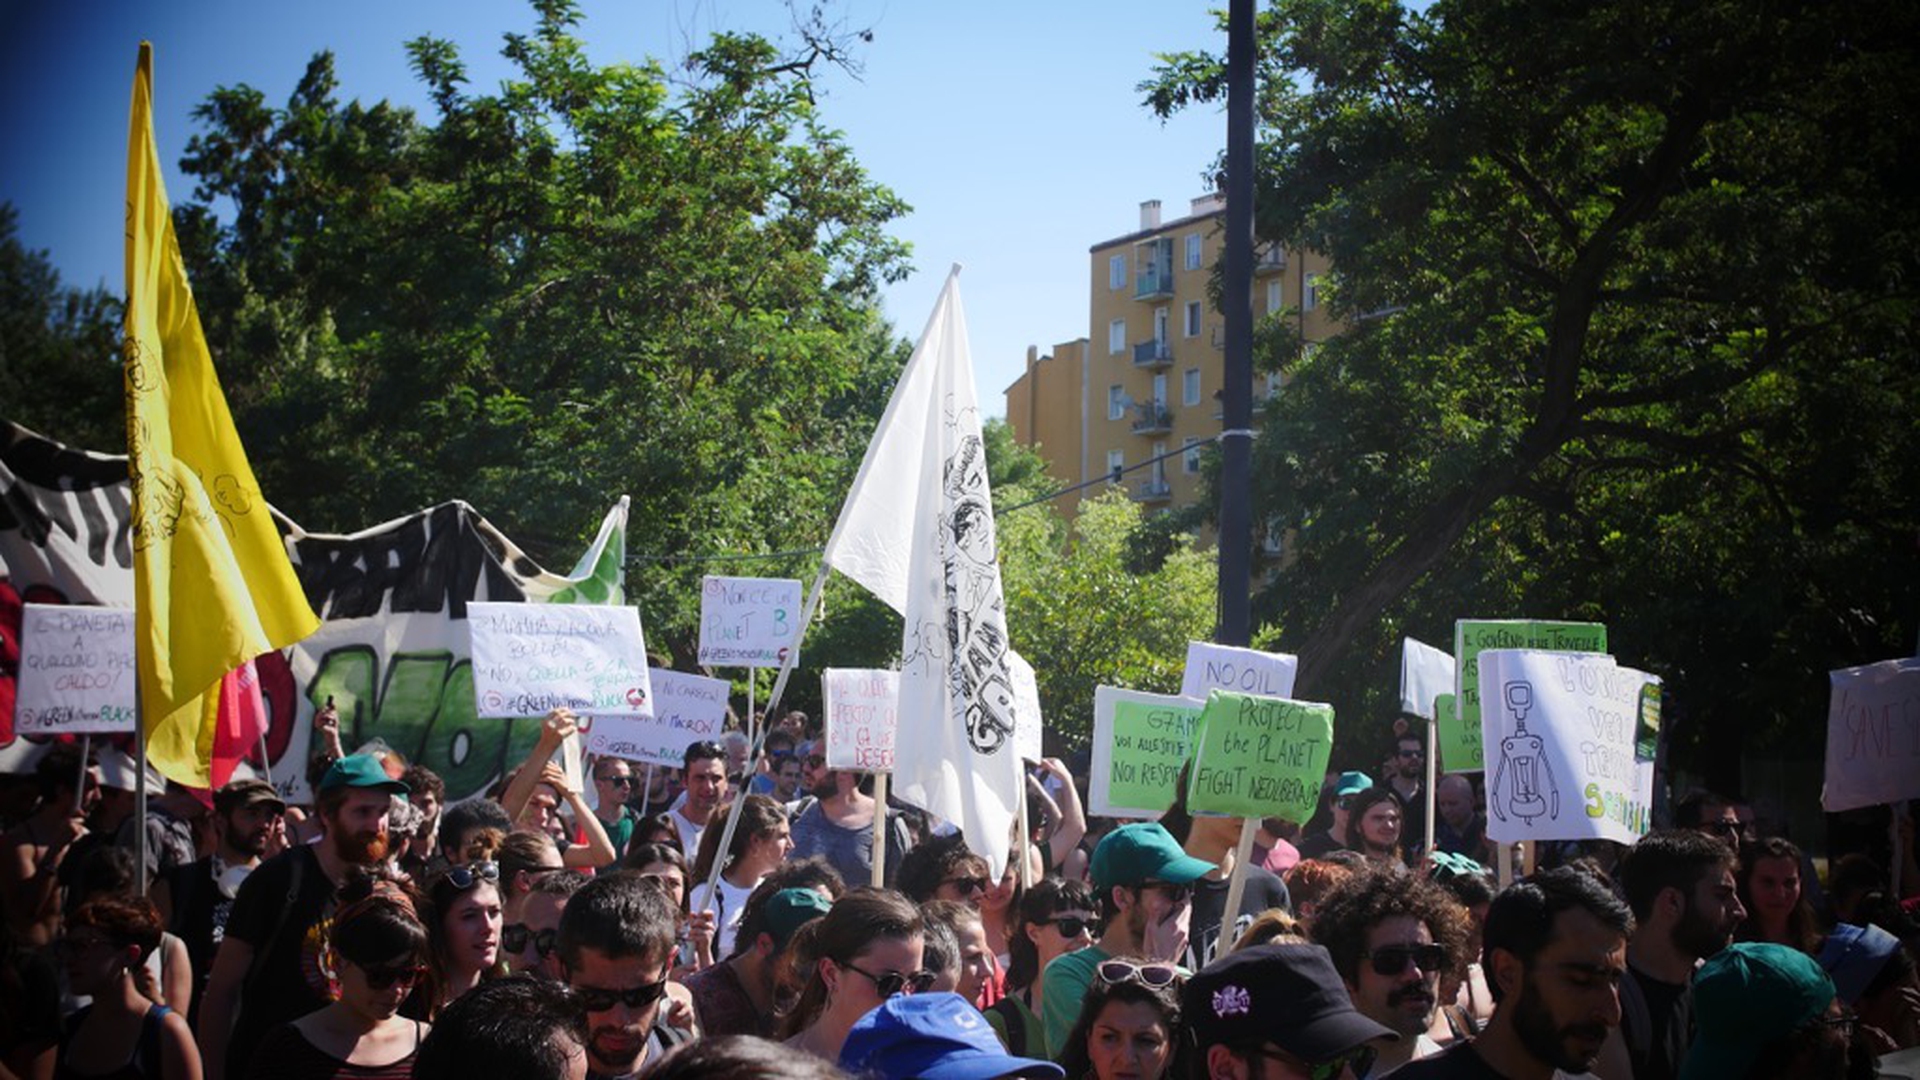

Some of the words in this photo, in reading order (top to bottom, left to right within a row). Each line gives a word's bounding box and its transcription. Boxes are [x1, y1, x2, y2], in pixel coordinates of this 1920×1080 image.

[706, 610, 757, 645] PLANET
[773, 608, 789, 637] B
[1477, 629, 1525, 649] GOVERNO
[73, 635, 84, 651] A
[1207, 661, 1236, 686] NO
[1240, 668, 1277, 695] OIL
[669, 712, 716, 734] MACRON
[1238, 698, 1306, 732] PROTECT
[1115, 735, 1132, 749] VOI
[1224, 732, 1249, 754] the
[1256, 735, 1320, 769] PLANET
[1113, 761, 1136, 783] NOI
[1196, 766, 1247, 796] FIGHT
